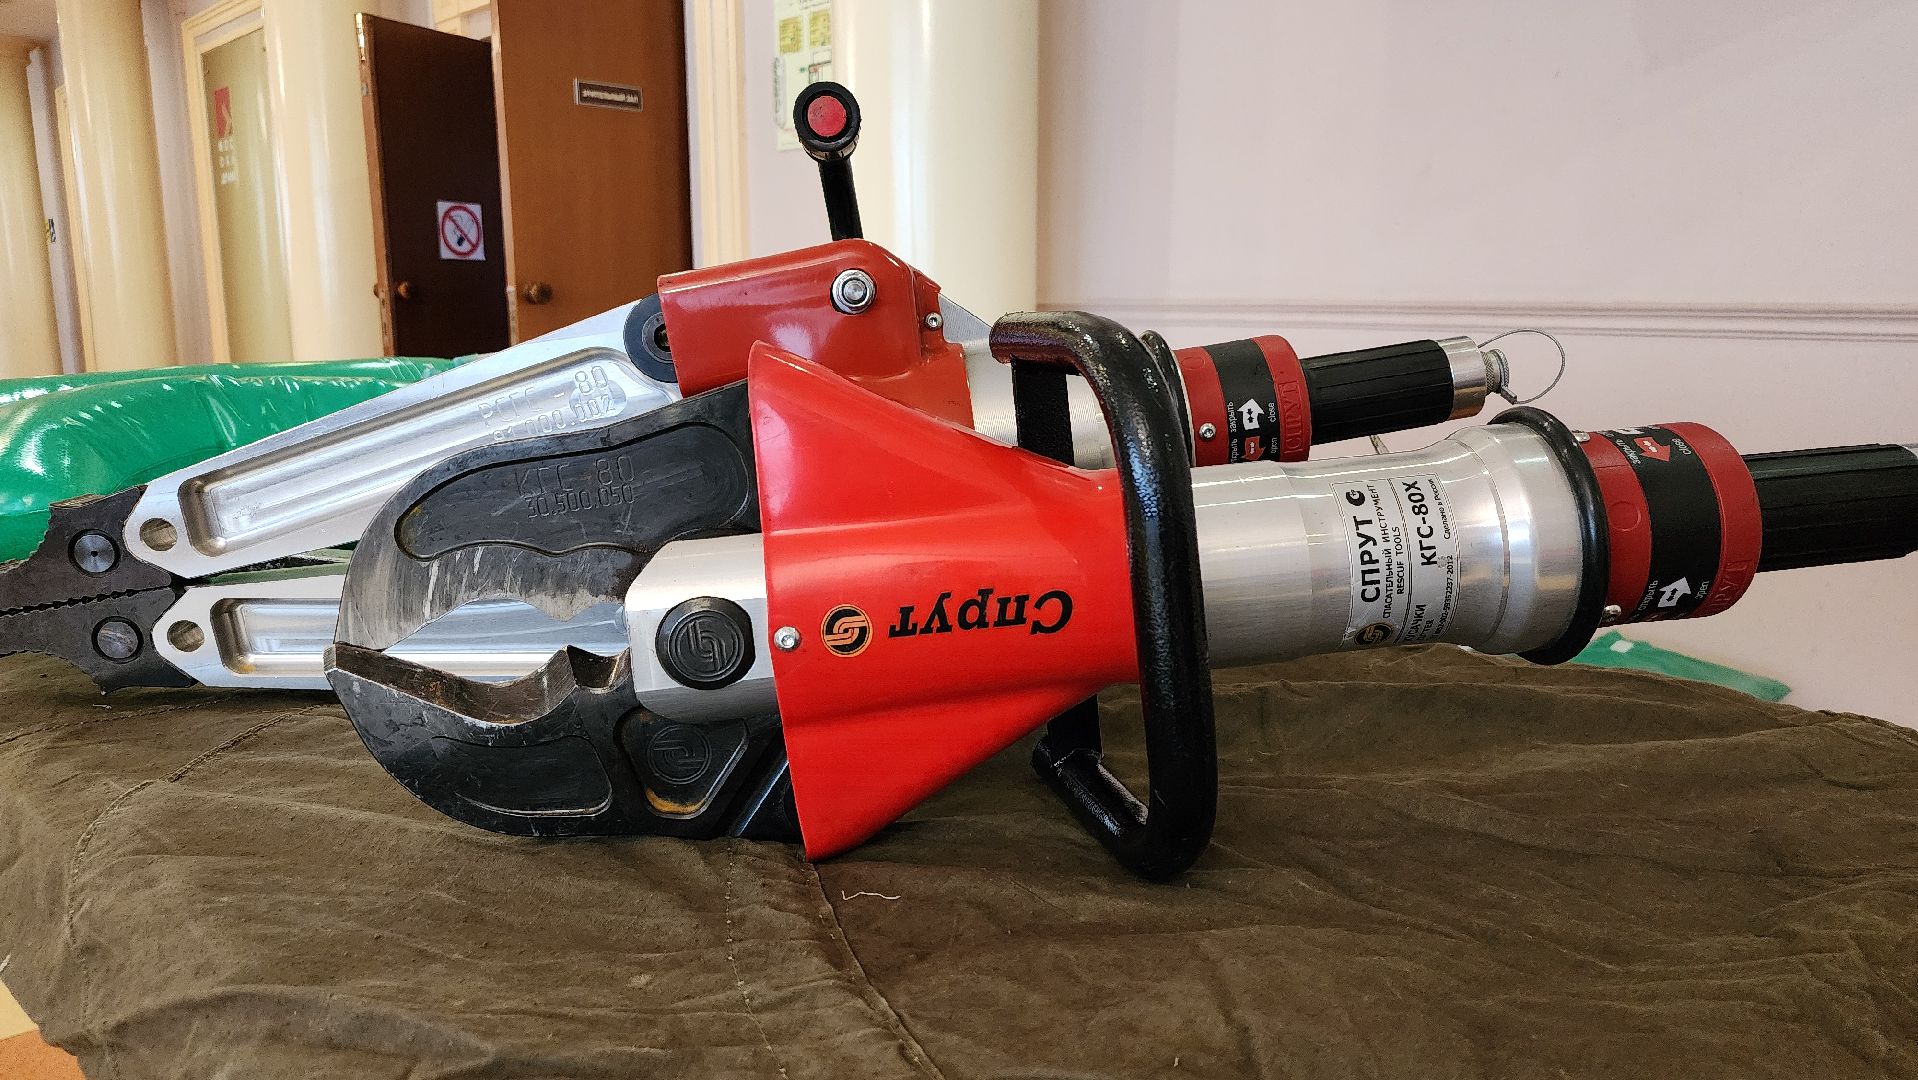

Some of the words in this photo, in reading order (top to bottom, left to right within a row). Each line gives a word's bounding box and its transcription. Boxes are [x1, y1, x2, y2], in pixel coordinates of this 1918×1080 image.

[1227, 401, 1238, 433] закрыть
[1268, 402, 1277, 423] close
[1616, 438, 1641, 465] закрыть
[1671, 437, 1692, 455] close
[515, 461, 573, 497] КГС
[594, 454, 635, 486] 80
[1427, 478, 1441, 501] России
[524, 484, 635, 519] 30.500.050
[1367, 484, 1390, 543] ИНСТРУМЕНТ
[1401, 480, 1438, 566] КГС-80Х
[1438, 506, 1451, 540] Сделано
[1392, 526, 1403, 556] TOOLS
[1352, 515, 1381, 603] СПРУТ
[1382, 548, 1394, 619] СПАСАТЕЛЬНЫЙ
[1639, 580, 1658, 611] открыть
[888, 588, 1073, 638] Спрут
